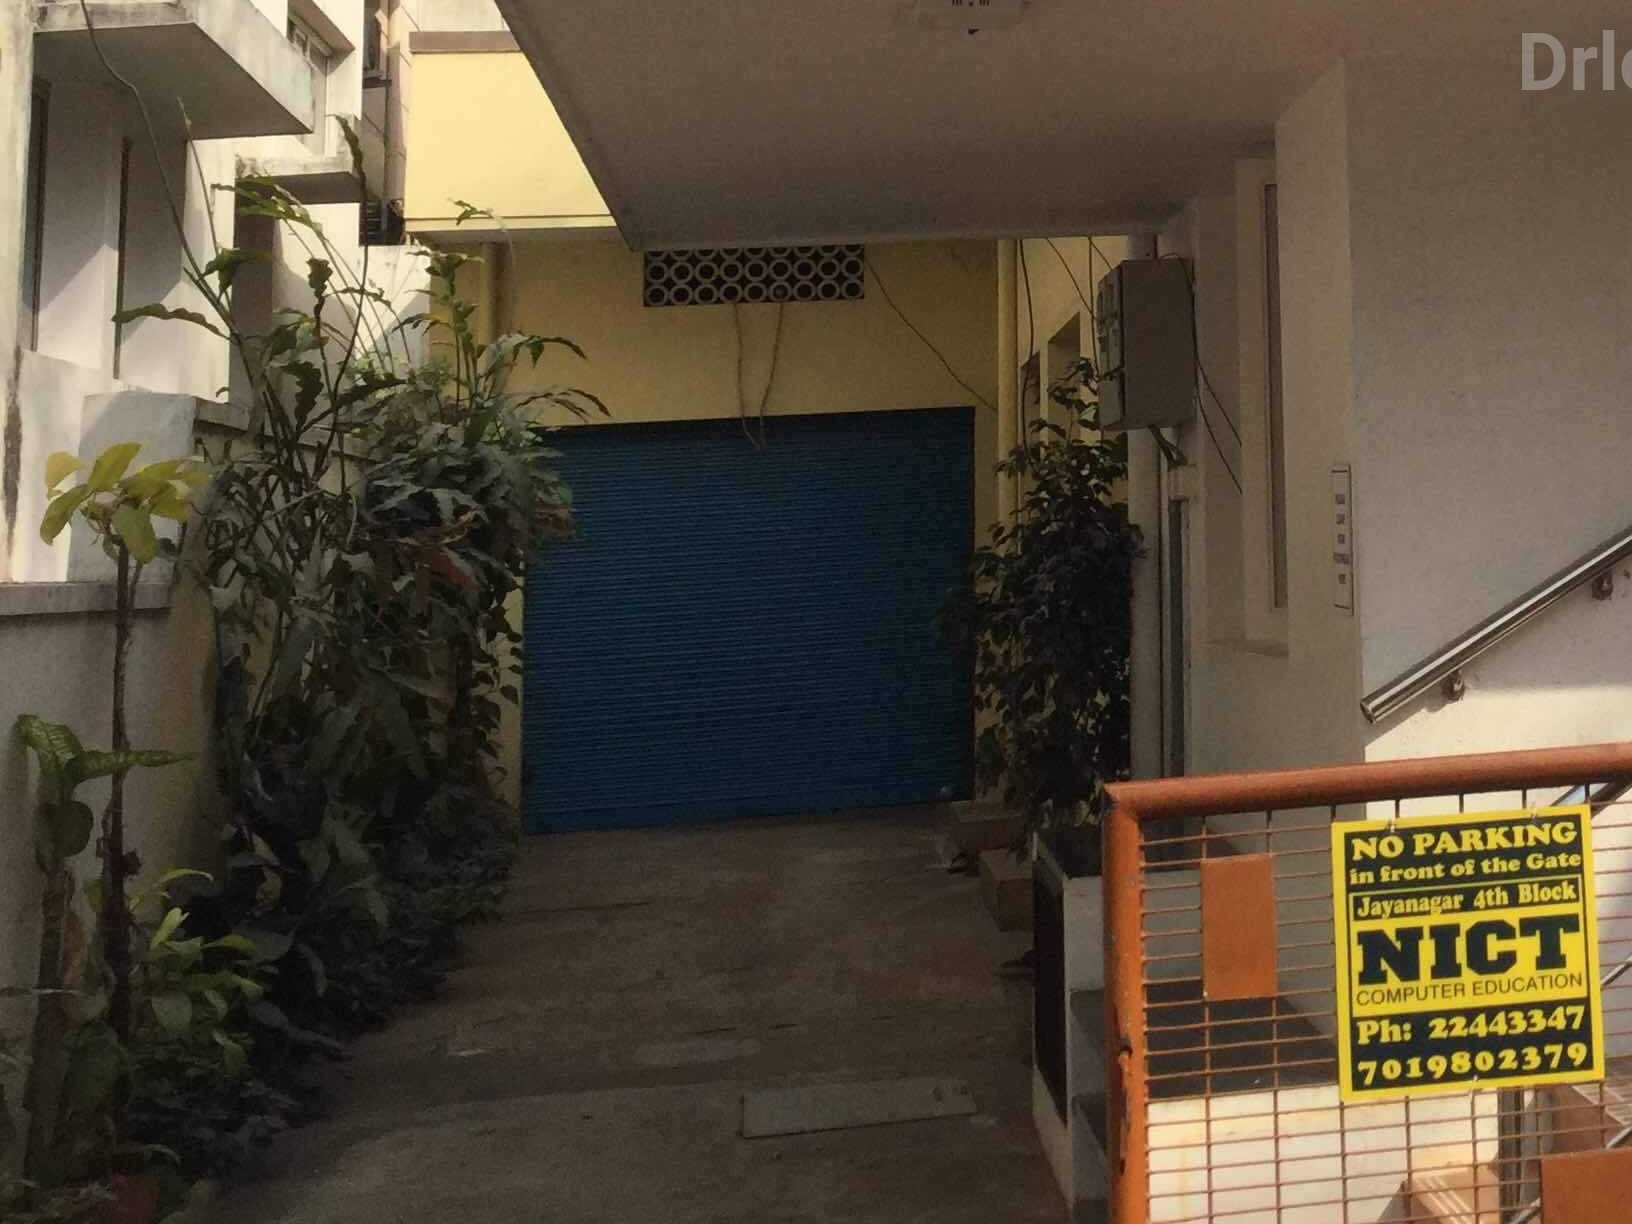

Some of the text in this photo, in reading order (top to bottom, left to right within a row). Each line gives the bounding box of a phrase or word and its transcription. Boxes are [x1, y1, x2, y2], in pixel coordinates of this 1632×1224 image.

[1351, 822, 1577, 861] NO PARKING
[1350, 852, 1582, 884] in front of the Gate
[1357, 882, 1576, 919] Jayanagar 4th Block
[1357, 913, 1580, 986] NICT
[1357, 973, 1582, 1006] COMPUTER EDUCATION
[1357, 1006, 1585, 1045] Ph: 22443347
[1358, 1043, 1587, 1085] 7019802379
